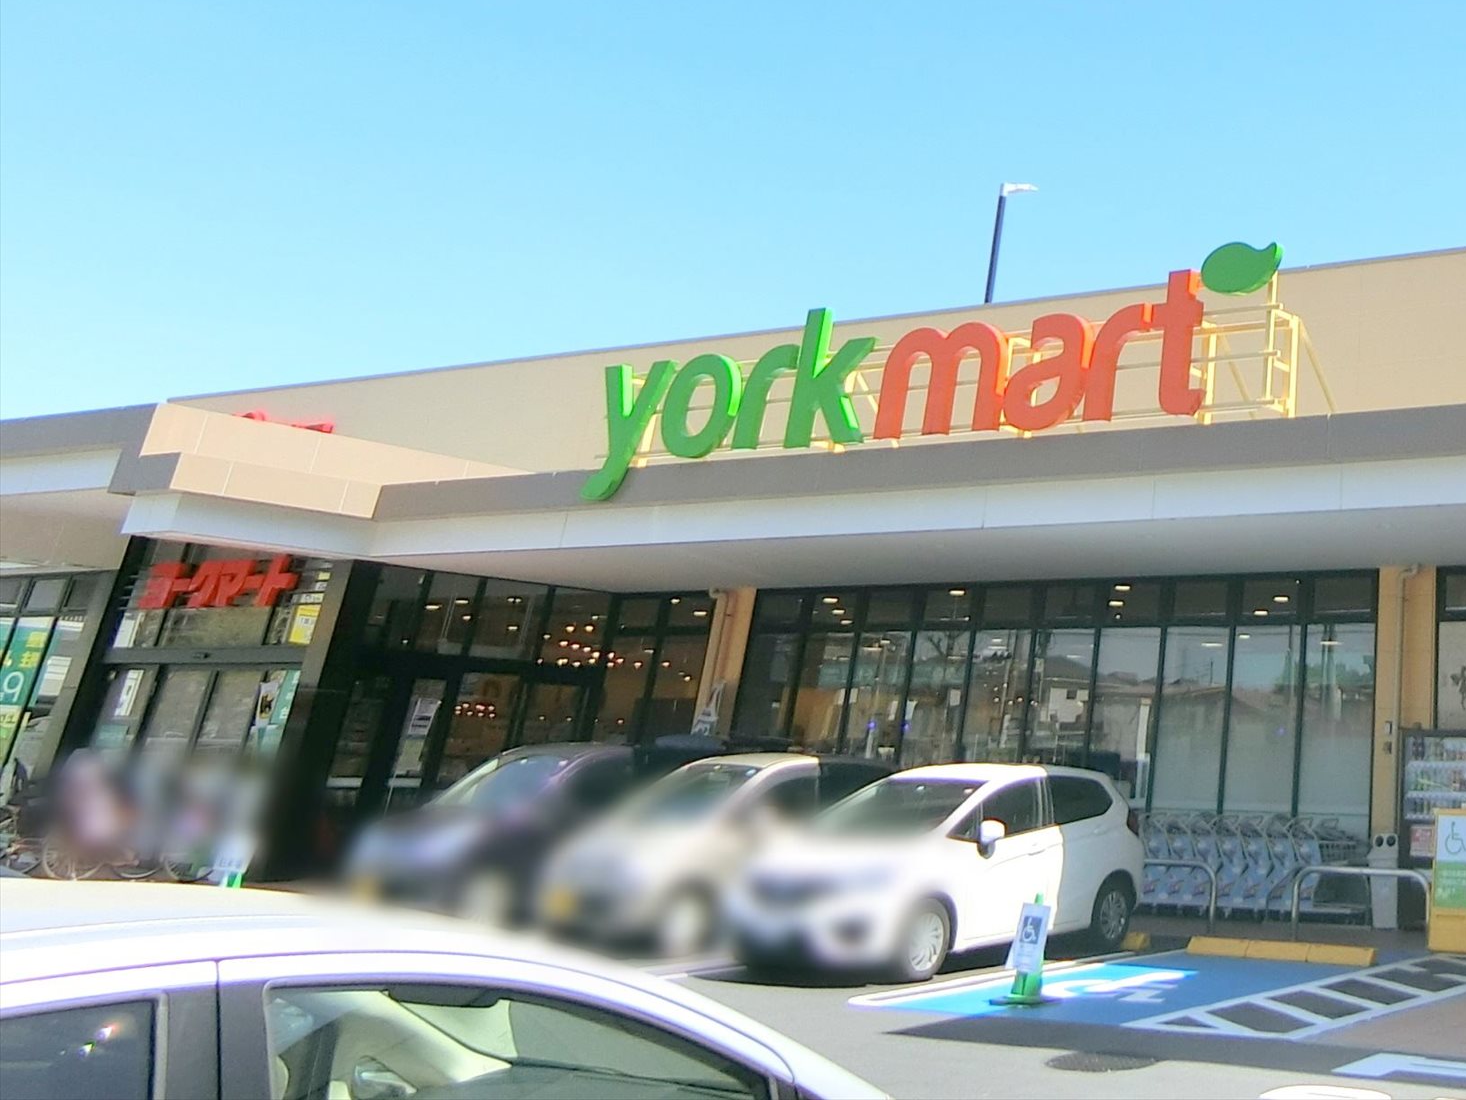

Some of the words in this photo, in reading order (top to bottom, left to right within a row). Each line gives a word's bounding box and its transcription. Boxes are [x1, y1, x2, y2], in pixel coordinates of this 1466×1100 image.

[138, 554, 299, 610] ヨークマート
